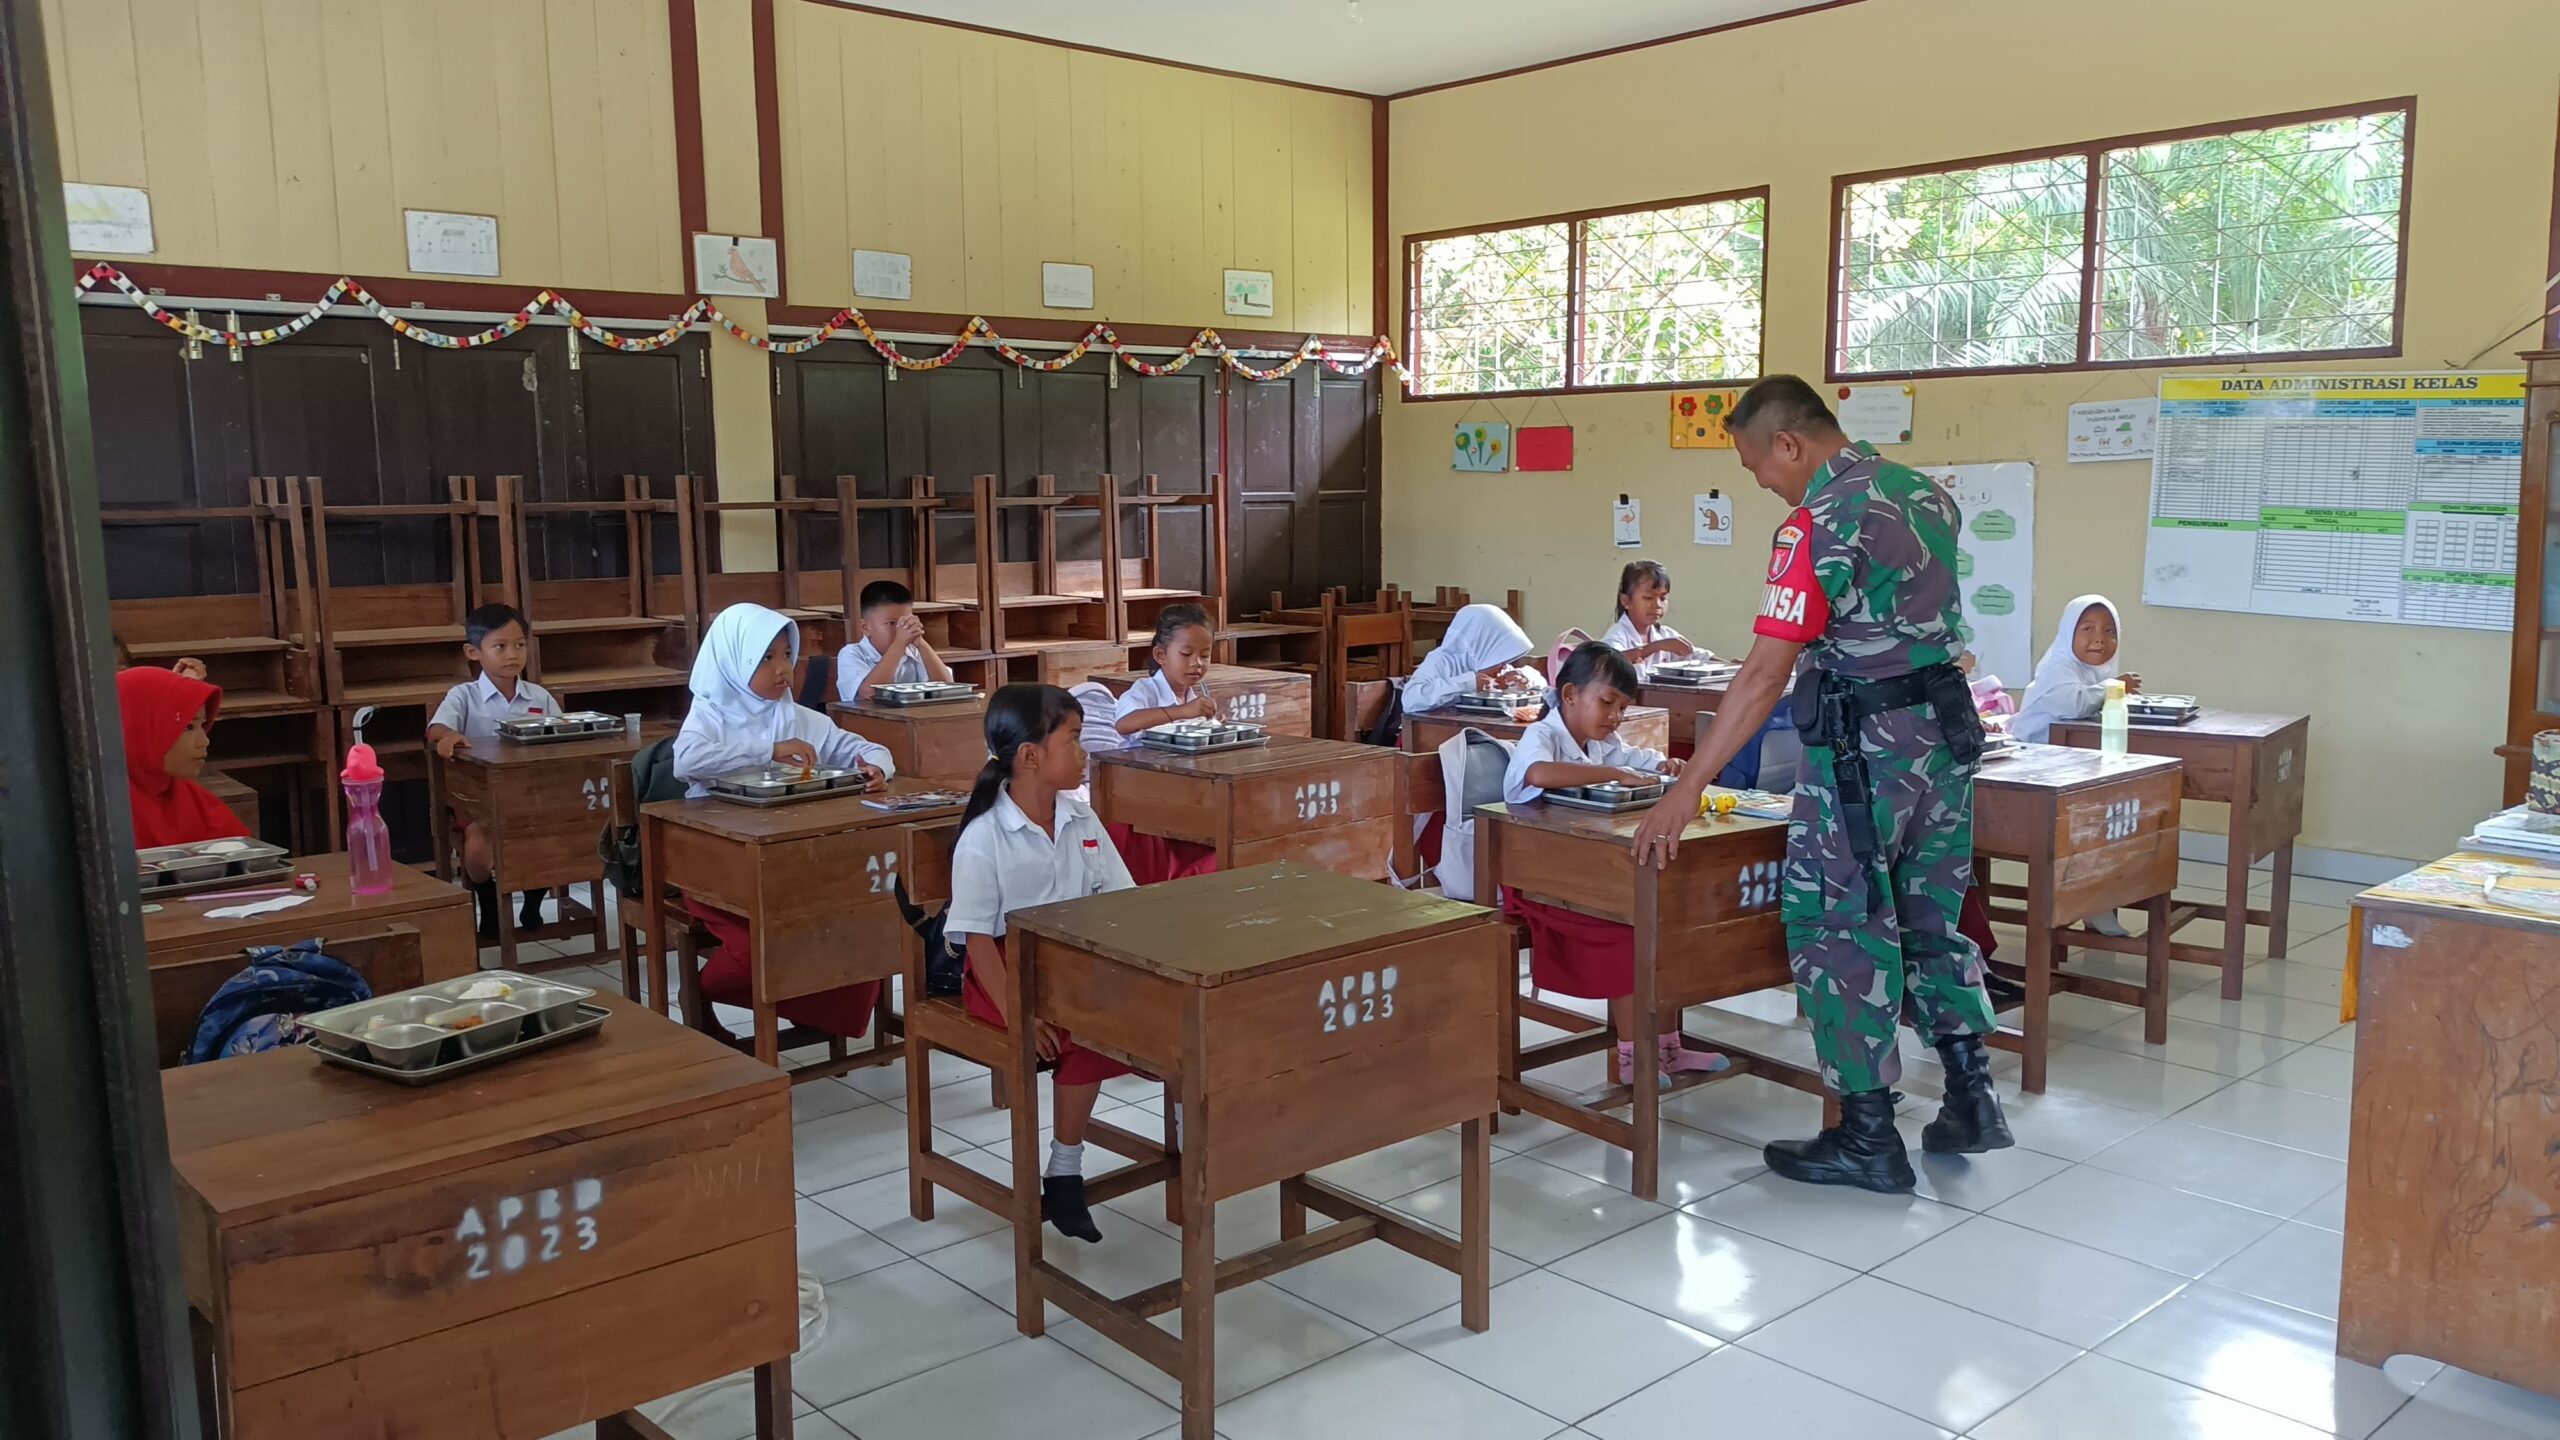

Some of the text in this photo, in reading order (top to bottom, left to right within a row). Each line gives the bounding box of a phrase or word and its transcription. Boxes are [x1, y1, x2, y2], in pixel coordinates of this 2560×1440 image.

[2221, 377, 2478, 391] DATA ADMINISTRASI KELAS
[2177, 520, 2229, 528] PENGUMUMAN
[1761, 584, 1807, 626] INSA
[1230, 693, 1266, 708] APBD
[1231, 705, 1265, 720] 2023
[582, 777, 609, 794] AP
[1295, 780, 1341, 800] APBD
[587, 794, 610, 810] 20
[1297, 798, 1338, 819] 2023
[866, 851, 898, 872] AP
[869, 872, 897, 893] 20
[1740, 882, 1784, 907] 202
[1318, 966, 1398, 1008] APBD
[1323, 993, 1394, 1032] 2023
[456, 1178, 603, 1242] APBD
[467, 1216, 598, 1280] 2023
